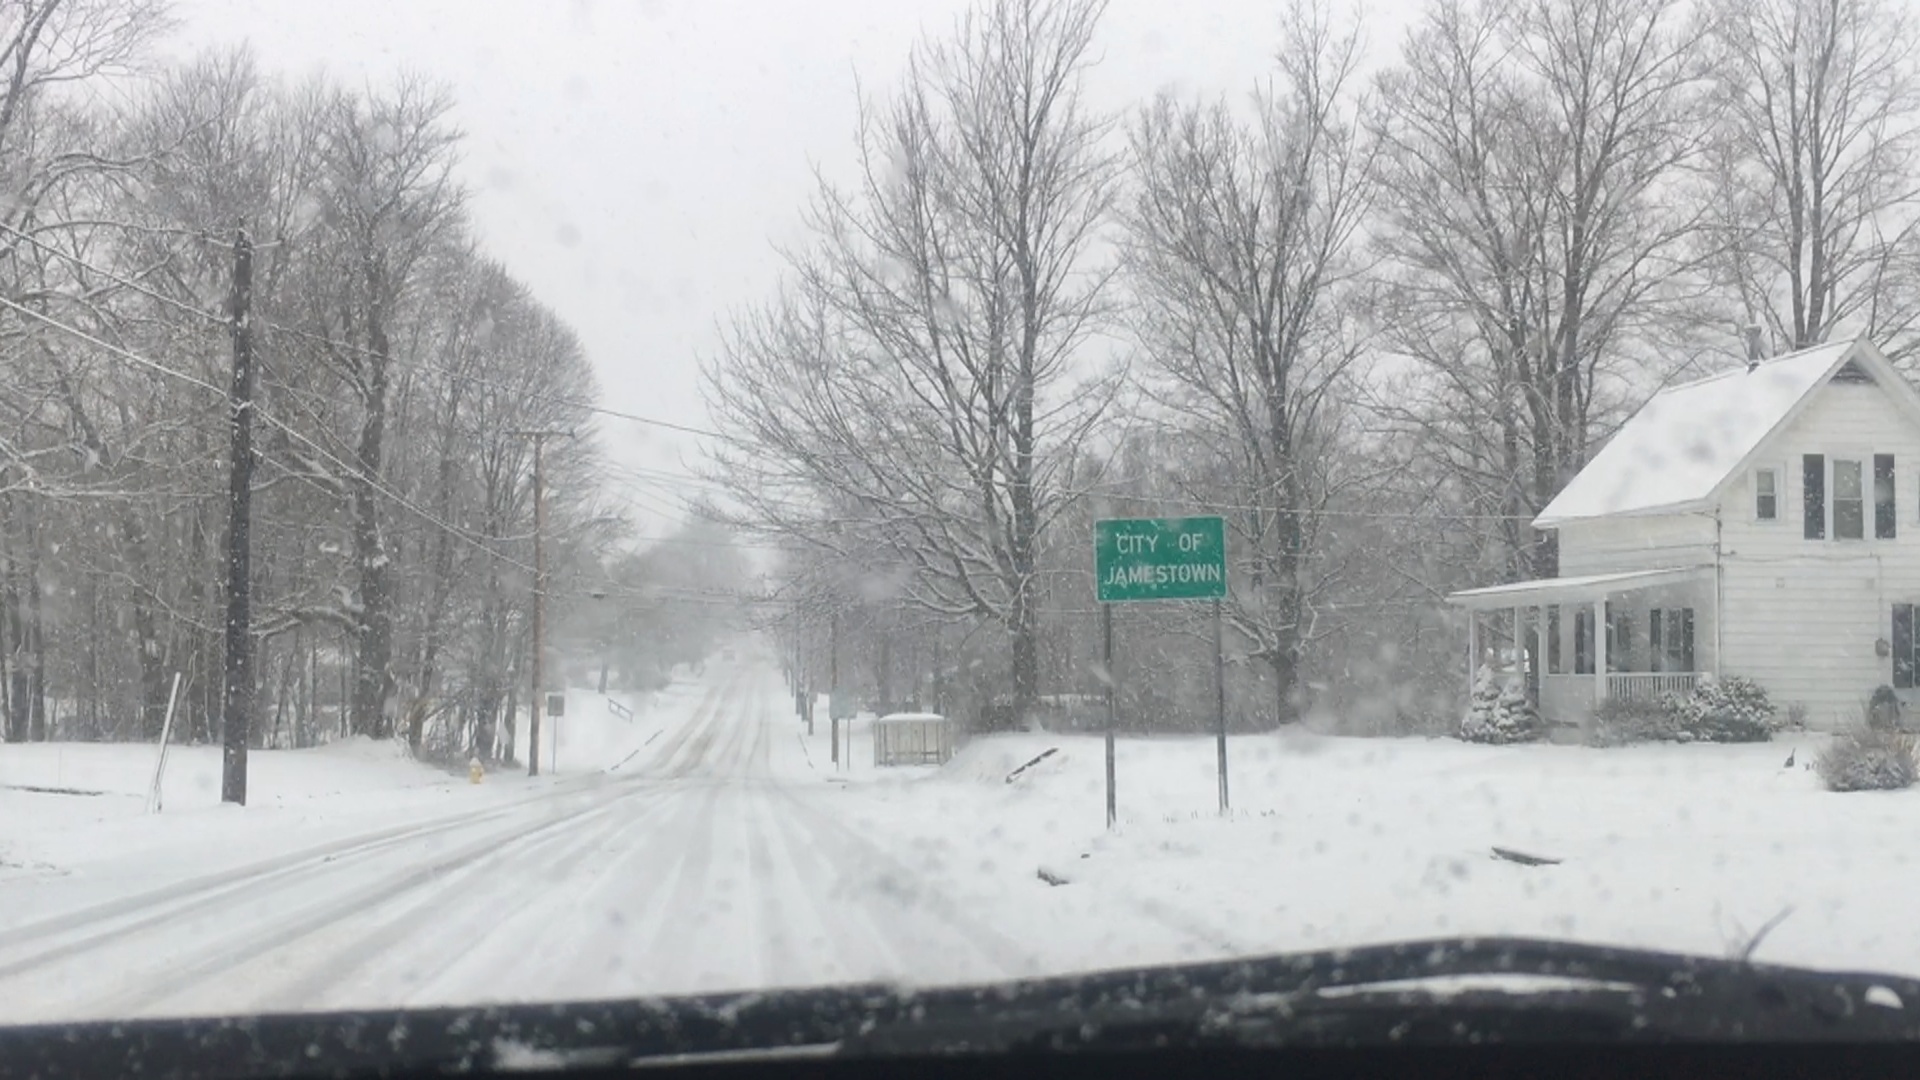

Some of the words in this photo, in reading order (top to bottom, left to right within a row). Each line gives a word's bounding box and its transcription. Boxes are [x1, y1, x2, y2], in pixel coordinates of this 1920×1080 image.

[1117, 534, 1158, 554] CITY
[1179, 533, 1203, 552] OF
[1105, 563, 1220, 585] JAMESTOWN
